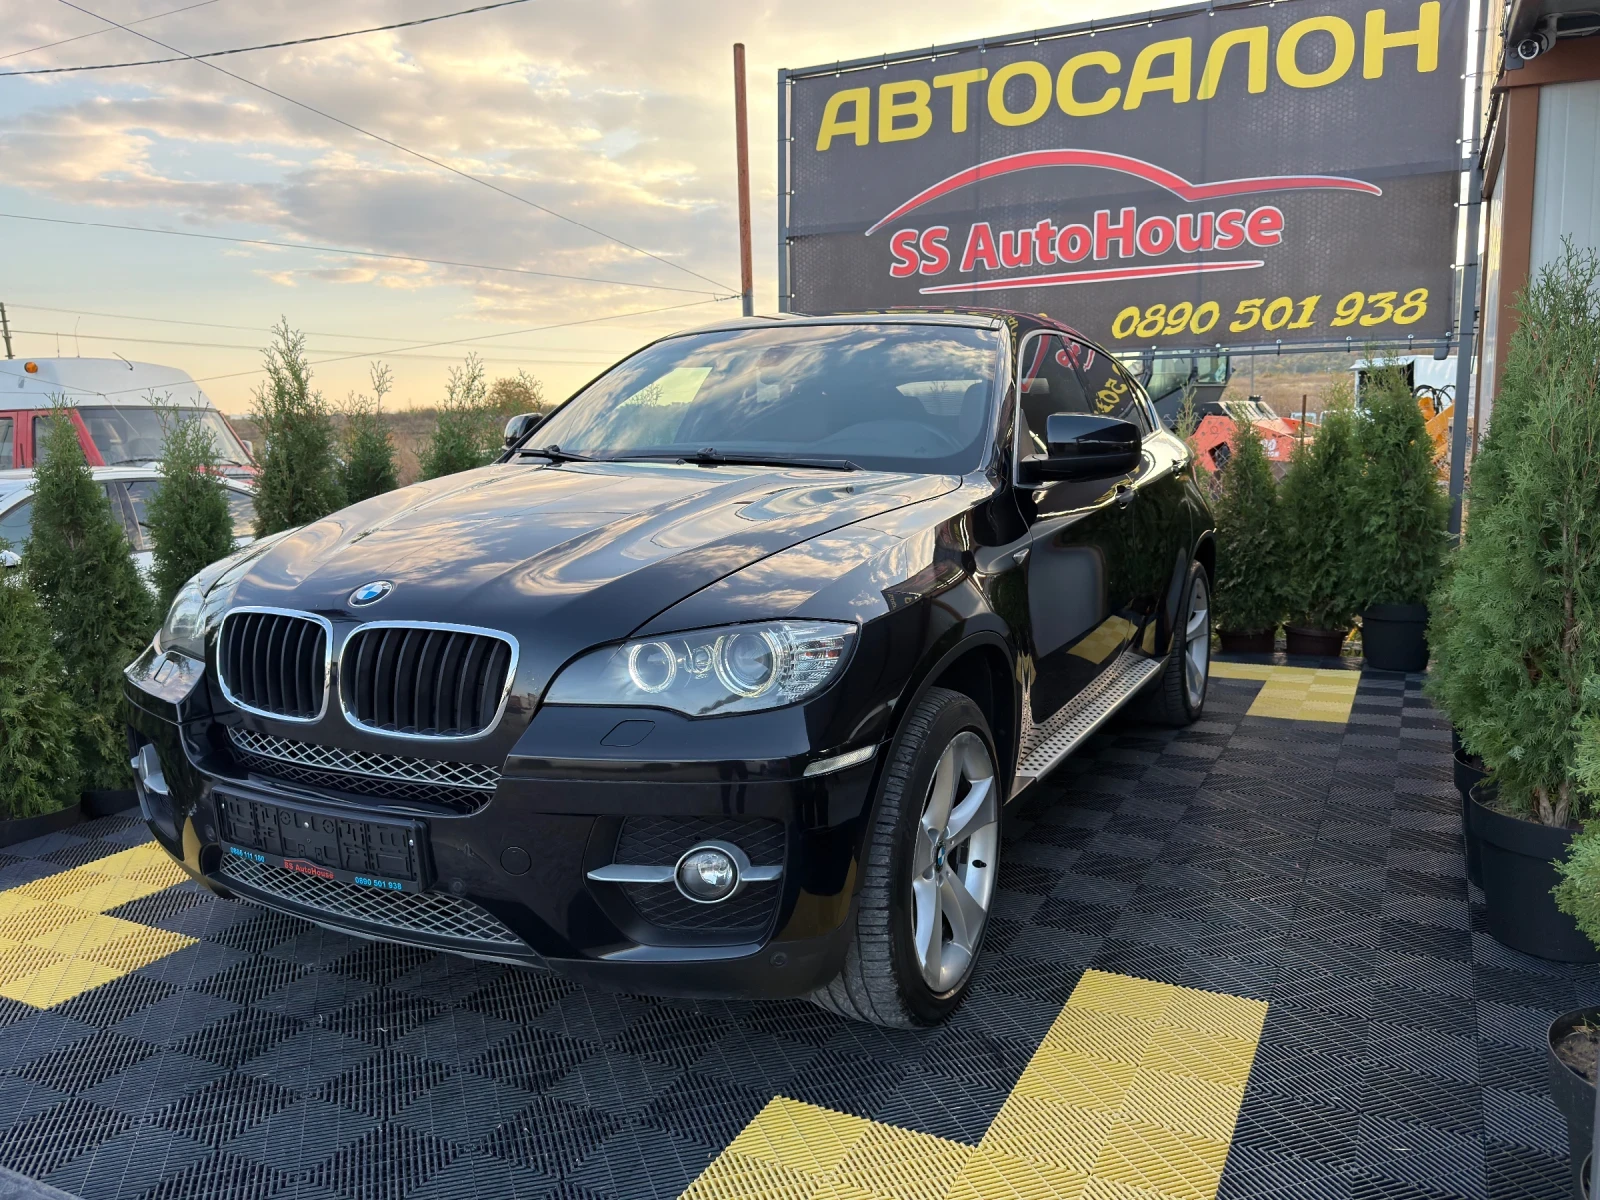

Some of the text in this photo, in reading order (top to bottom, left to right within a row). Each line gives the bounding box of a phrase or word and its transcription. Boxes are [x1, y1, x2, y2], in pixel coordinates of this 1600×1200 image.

[816, 2, 1440, 151] АВТОСАЛОН
[889, 206, 1284, 277] SS AutoHouse
[1112, 289, 1429, 340] 0890 501 938
[284, 861, 335, 880] SS AutoHouse
[373, 879, 386, 888] 501
[388, 881, 402, 890] 938
